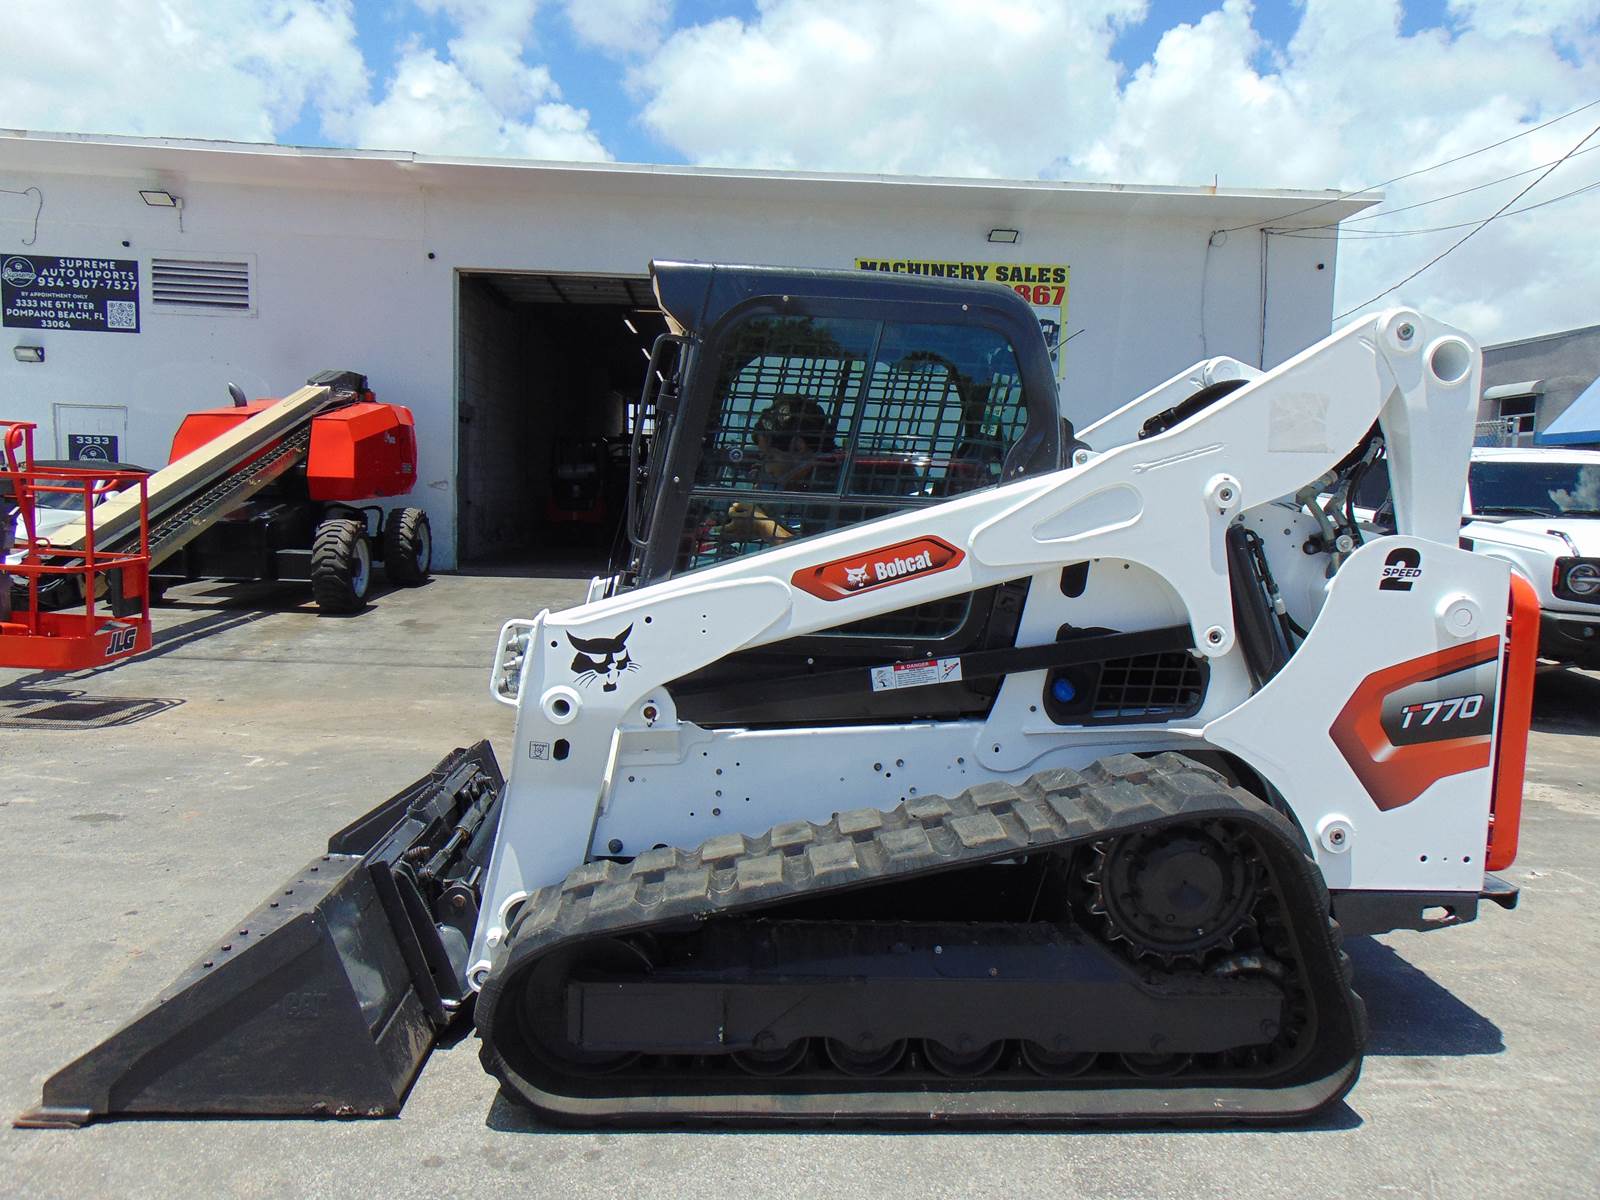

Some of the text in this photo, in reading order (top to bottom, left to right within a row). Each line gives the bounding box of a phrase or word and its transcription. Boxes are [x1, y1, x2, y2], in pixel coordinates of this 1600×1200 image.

[59, 259, 116, 269] SUPREME
[41, 268, 135, 280] AUTO IMPORTS
[860, 260, 1067, 284] MACHINERY SALES
[37, 277, 138, 291] 954-907-7527
[1002, 284, 1066, 306] 867
[16, 299, 95, 310] 3333 NE 6TH TER
[6, 308, 105, 321] POMPANO BEACH, FL
[41, 320, 71, 329] 33064
[76, 436, 110, 445] 3333
[874, 550, 933, 581] Bobcat
[1379, 547, 1422, 592] 2
[1382, 567, 1422, 578] SPEED
[105, 626, 138, 657] JLG
[906, 661, 930, 670] DANGER
[1401, 694, 1485, 730] T770
